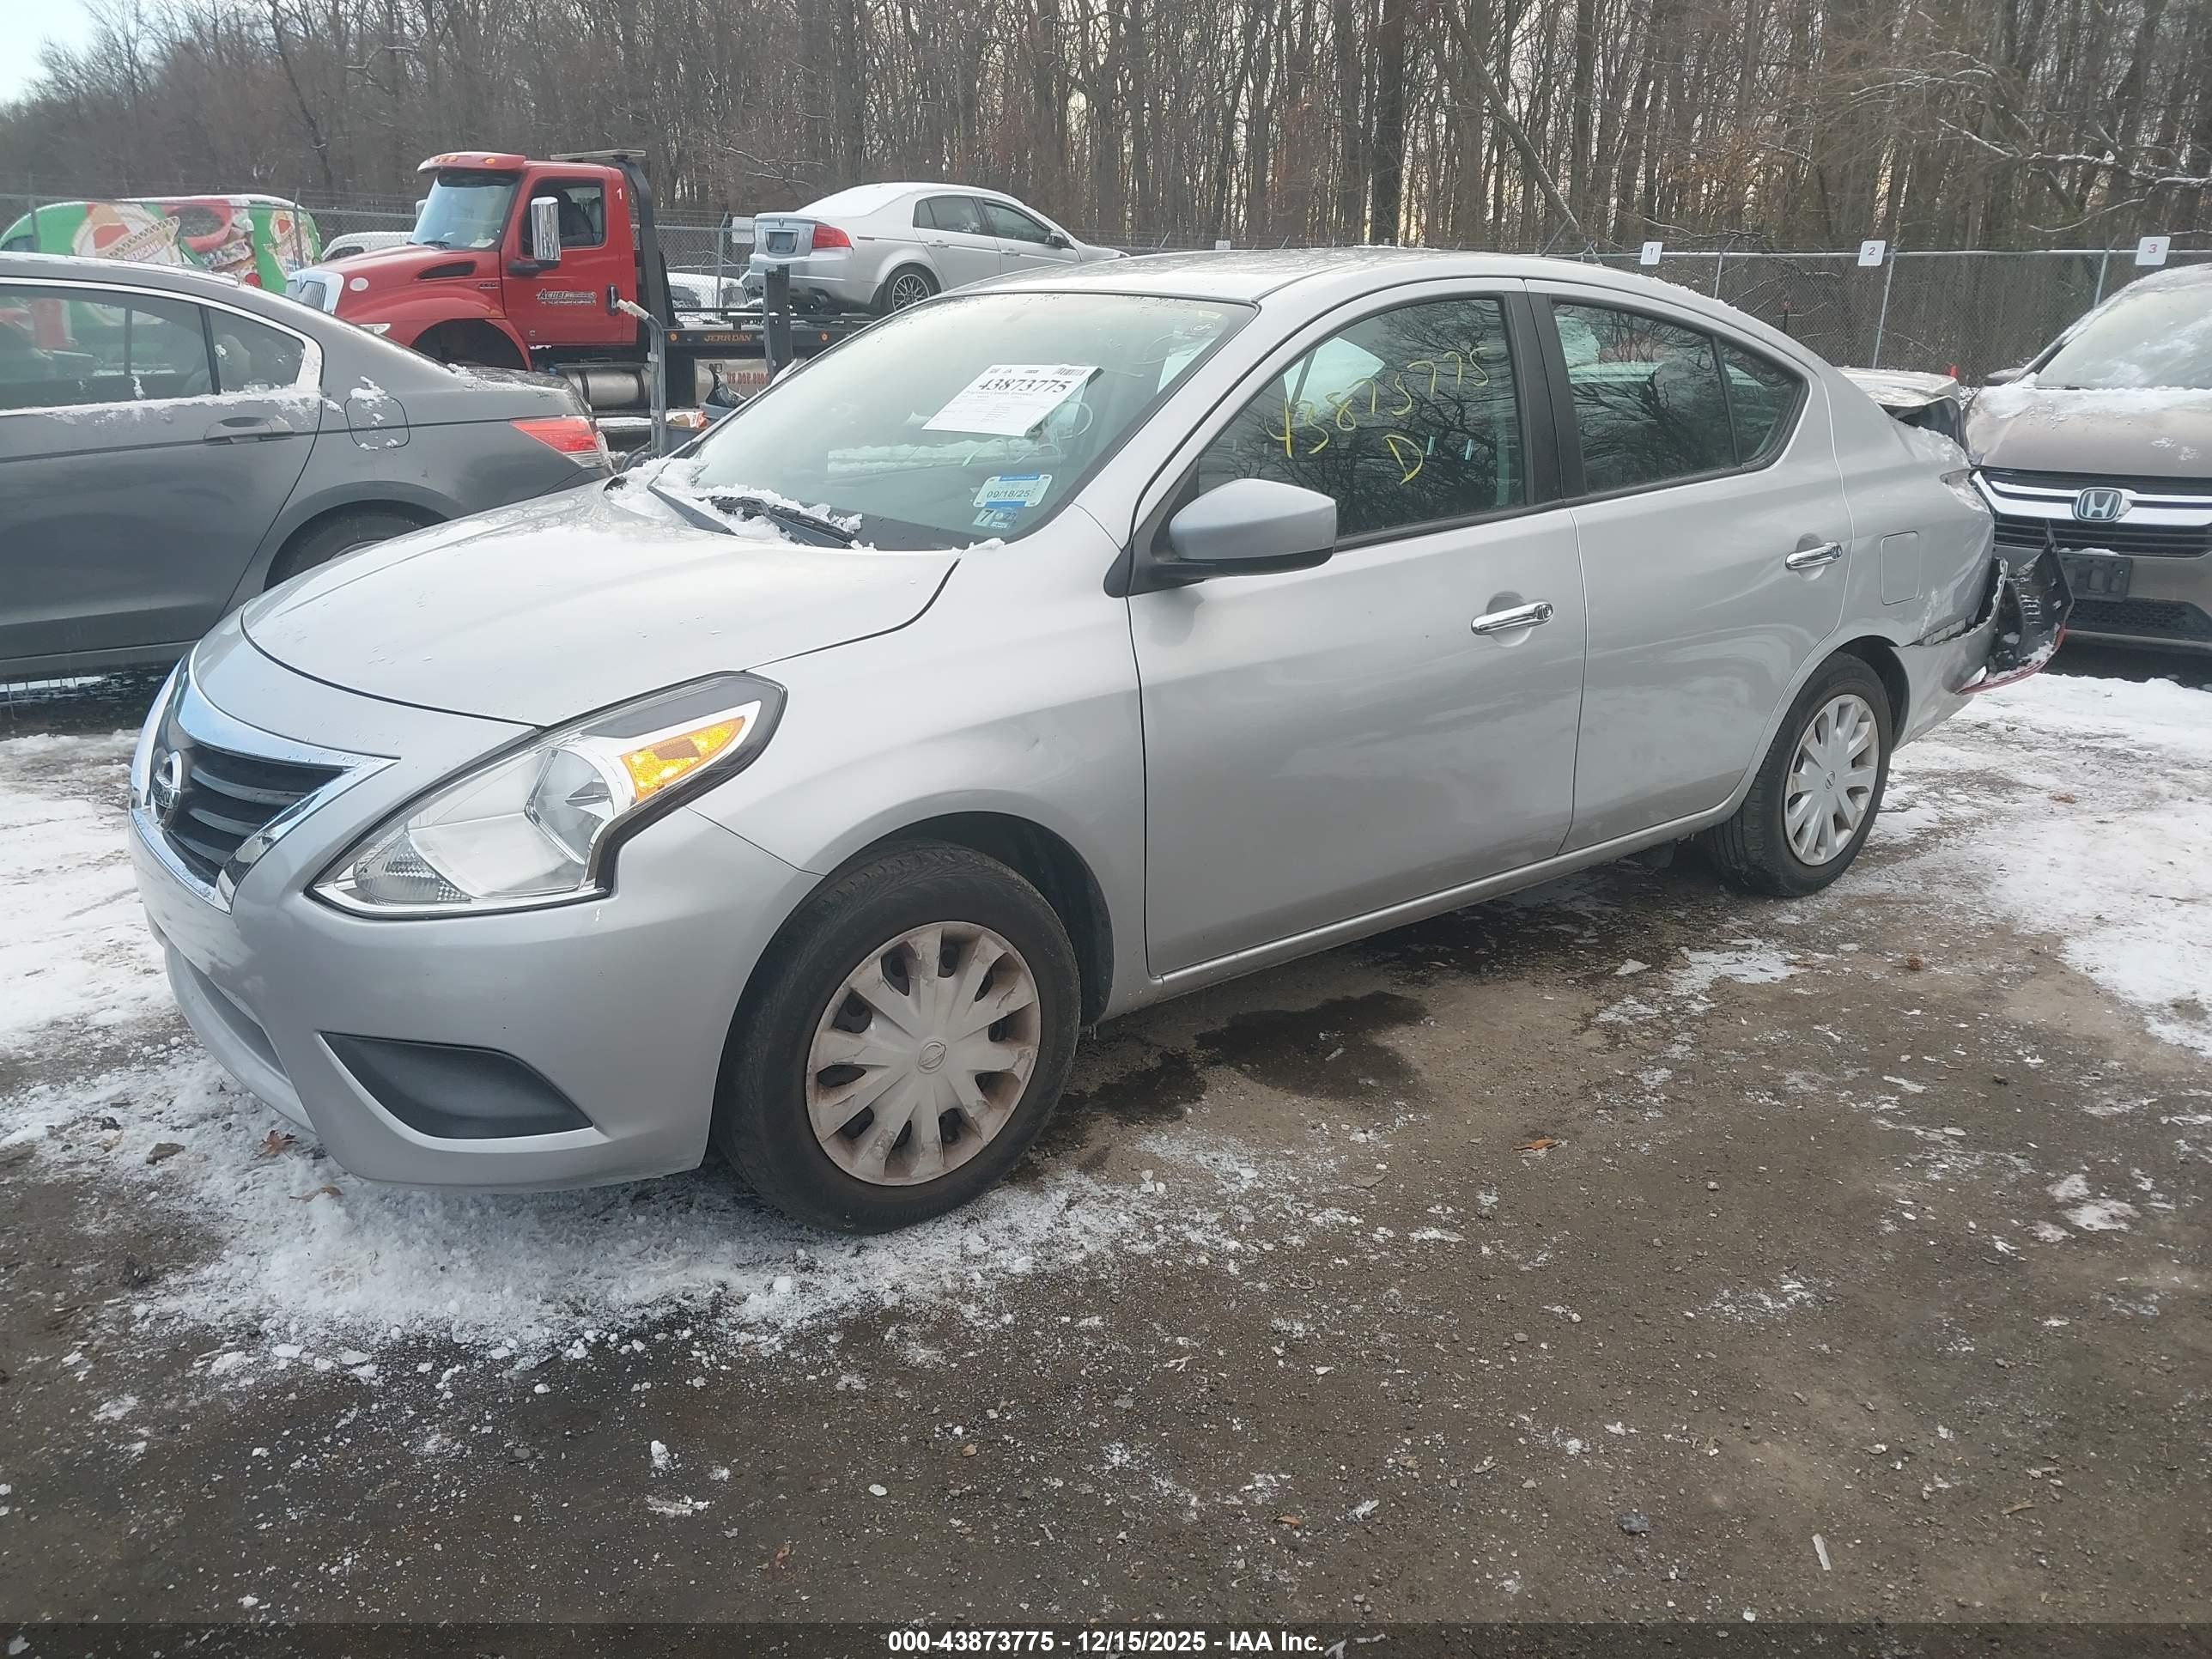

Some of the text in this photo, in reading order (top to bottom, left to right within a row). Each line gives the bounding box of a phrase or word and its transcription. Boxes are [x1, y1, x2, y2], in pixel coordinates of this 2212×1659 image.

[617, 187, 622, 199] 1
[1649, 246, 1654, 255] 1
[1868, 246, 1876, 256] 2
[2148, 243, 2158, 253] 3
[978, 378, 1073, 393] 43873775
[1382, 434, 1424, 486] D
[987, 489, 1031, 498] 09/18/25
[980, 510, 994, 522] 7
